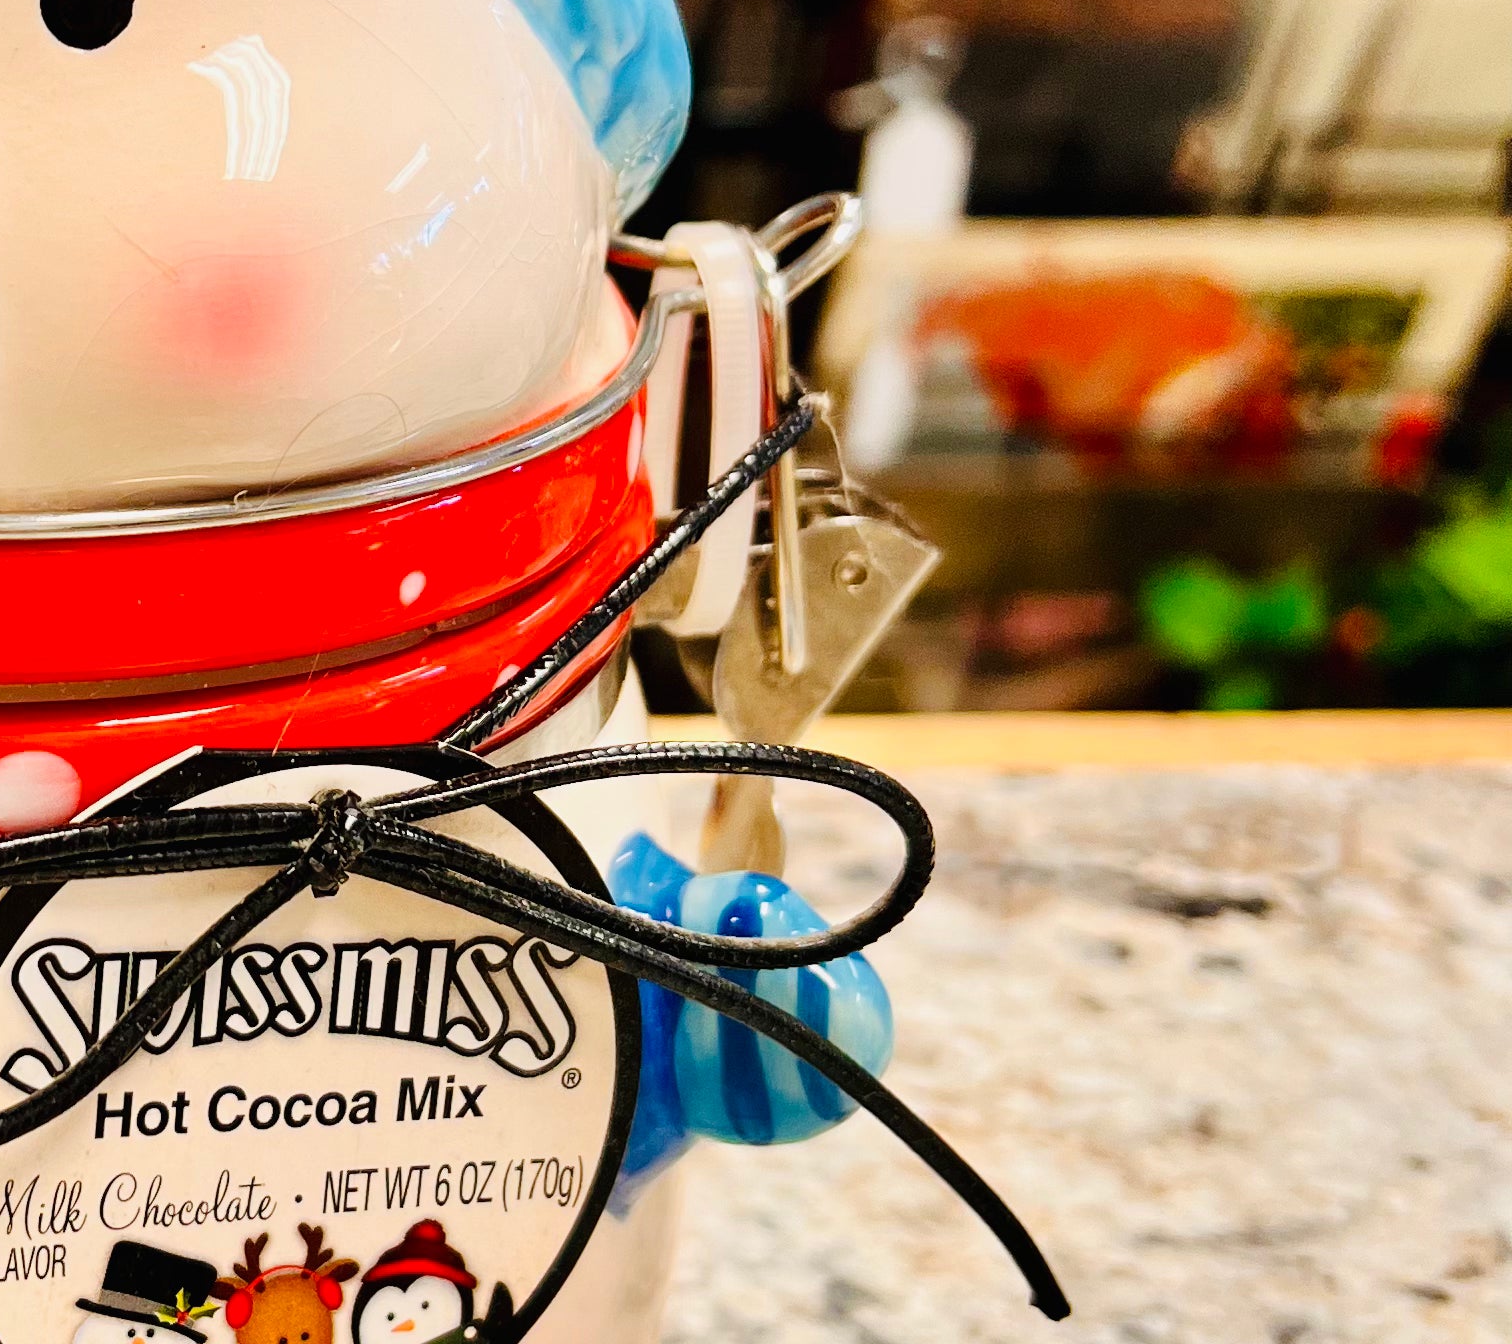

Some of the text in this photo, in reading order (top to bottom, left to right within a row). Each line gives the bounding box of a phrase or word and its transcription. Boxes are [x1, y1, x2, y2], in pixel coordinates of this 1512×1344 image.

[94, 1074, 488, 1139] Hot Cocoa Mix
[99, 1169, 278, 1231] Chocolate
[322, 1168, 379, 1214] NET
[385, 1164, 431, 1209] WT
[435, 1164, 453, 1207] 6
[459, 1160, 497, 1205] OZ
[502, 1156, 584, 1212] (170g)
